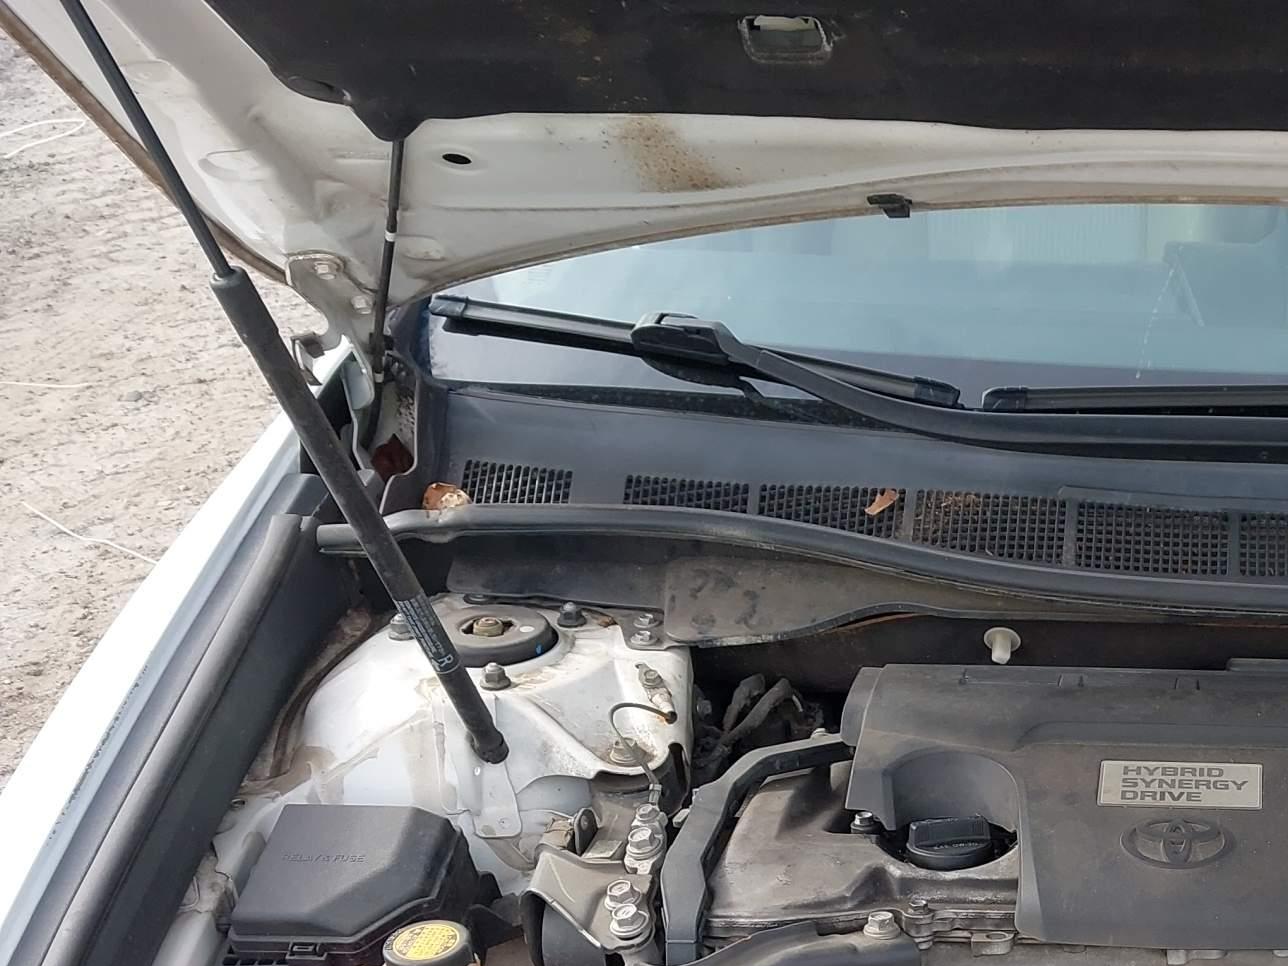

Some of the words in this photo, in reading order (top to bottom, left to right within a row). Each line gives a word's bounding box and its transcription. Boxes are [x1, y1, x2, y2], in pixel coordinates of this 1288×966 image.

[1123, 766, 1223, 777] HYBRID
[1122, 778, 1248, 790] SYNERGY
[1120, 790, 1202, 802] DRIVE
